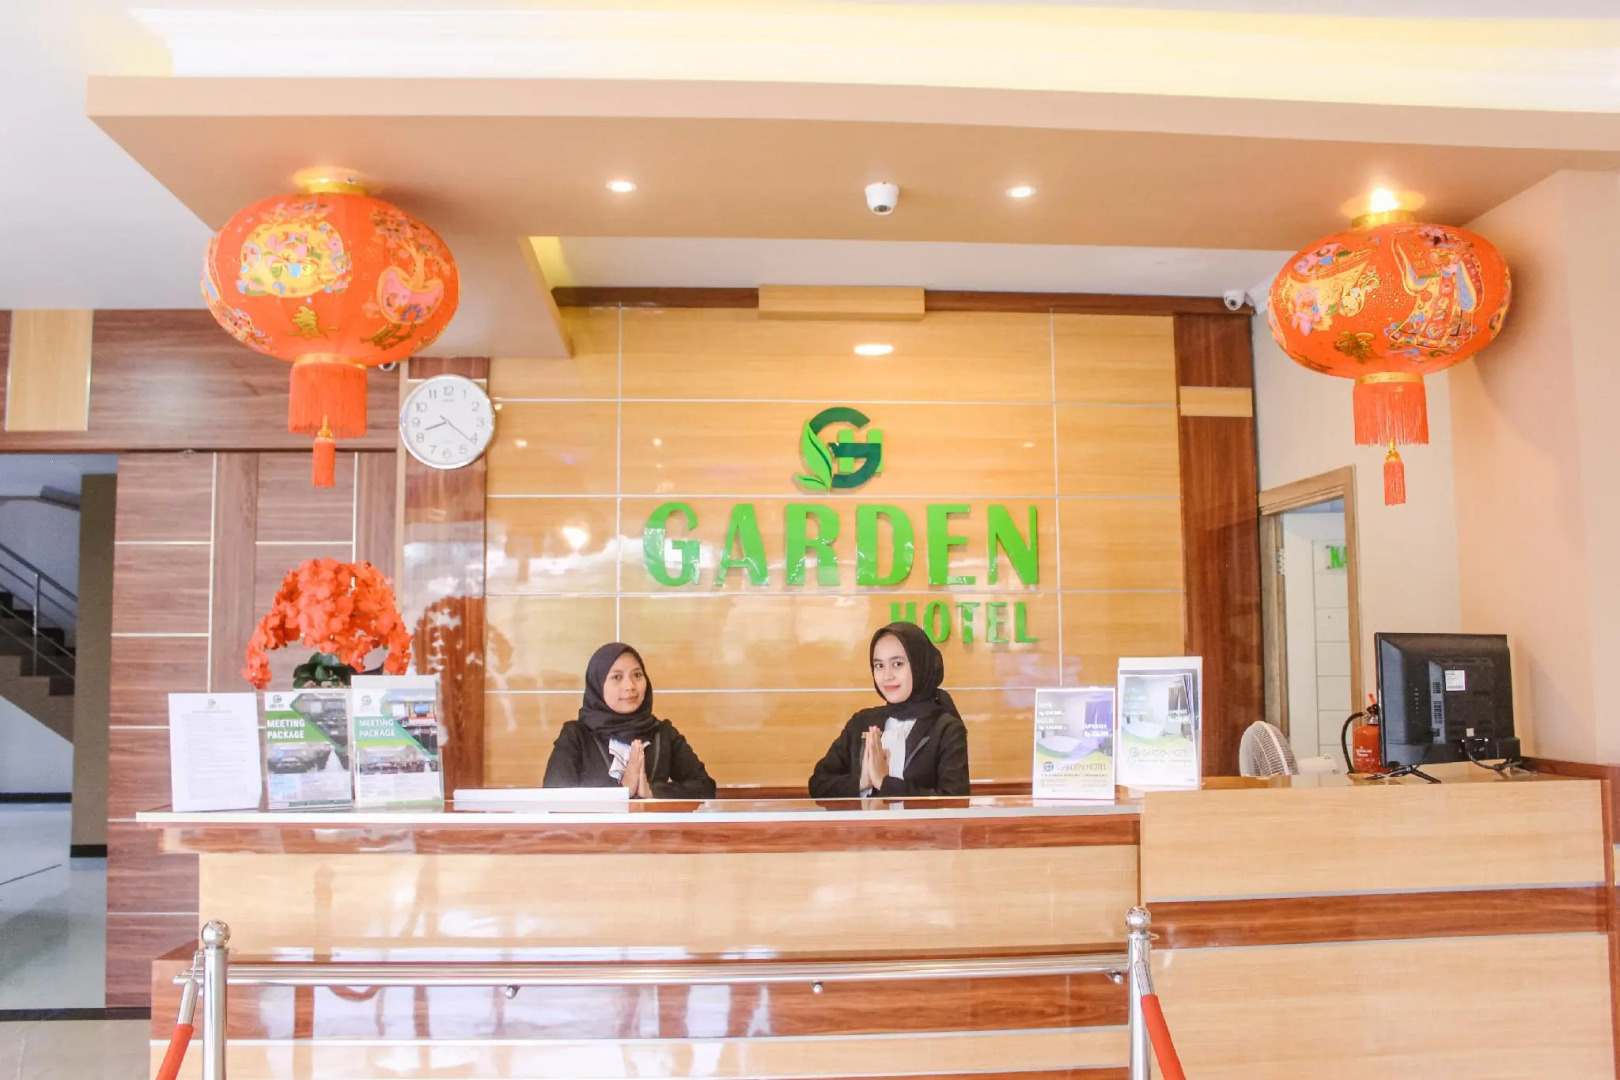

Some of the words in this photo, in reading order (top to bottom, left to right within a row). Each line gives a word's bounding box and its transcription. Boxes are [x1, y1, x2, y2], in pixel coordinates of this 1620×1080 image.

[429, 389, 437, 399] 11
[443, 386, 454, 396] 12
[416, 402, 428, 413] 10
[471, 401, 480, 412] 2
[411, 417, 420, 428] 9
[476, 417, 485, 427] 3
[416, 432, 424, 443] 8
[429, 444, 437, 455] 7
[442, 448, 452, 459] 6
[459, 444, 468, 454] 5
[642, 501, 1039, 587] GARDEN
[890, 601, 1039, 644] HOTEL
[267, 719, 305, 728] MEETING
[359, 719, 394, 727] MEETING
[267, 730, 305, 739] PACKAGE
[359, 729, 395, 737] PACKAGE
